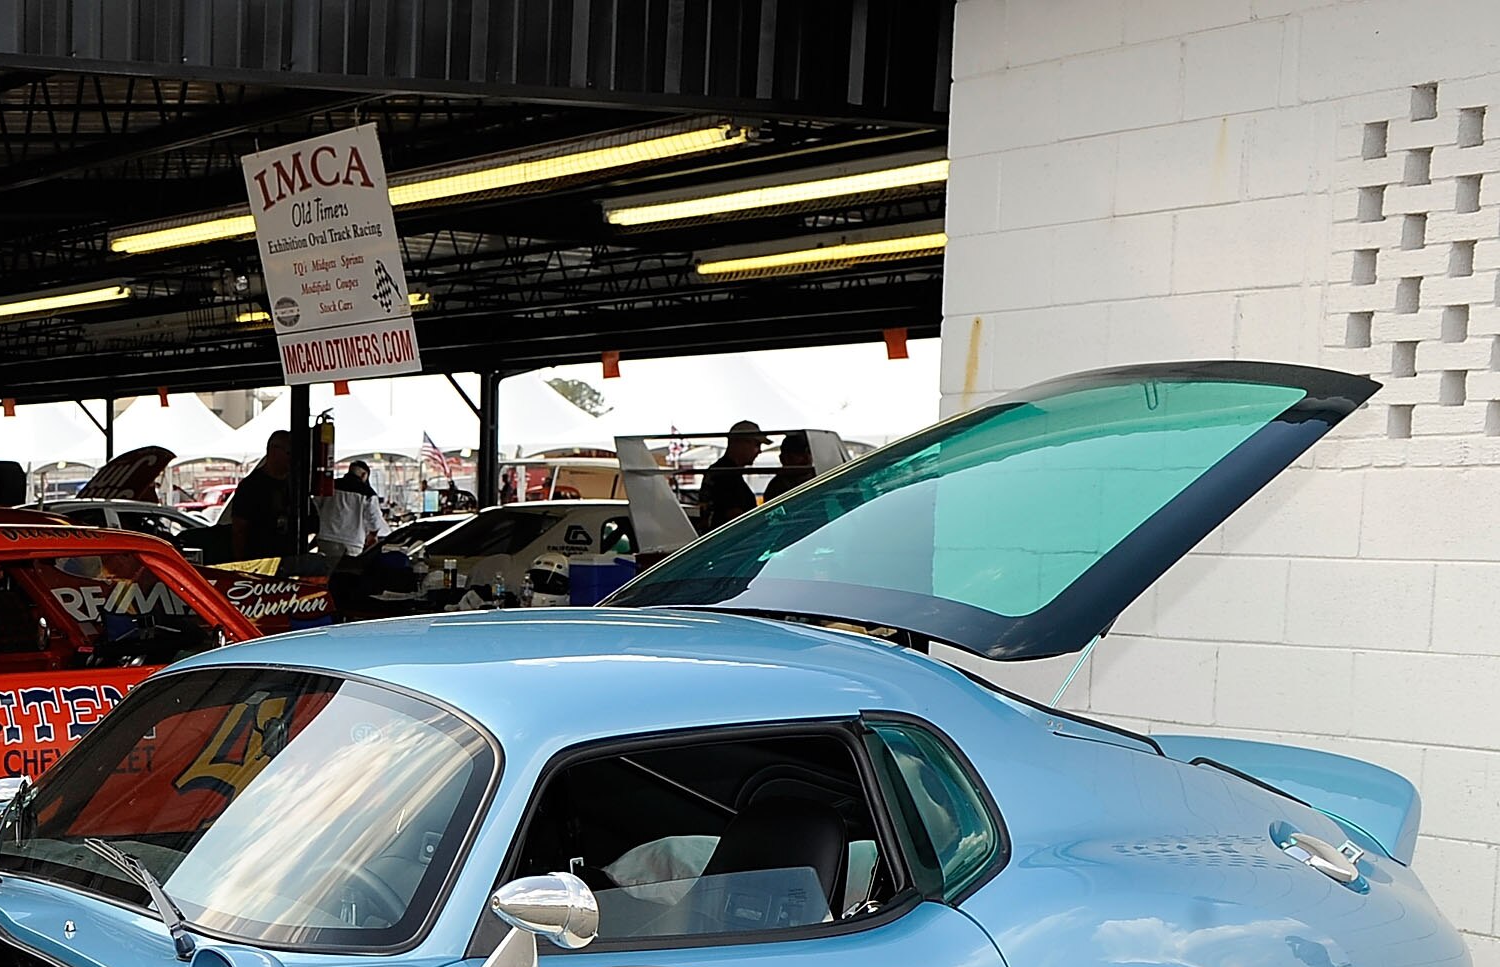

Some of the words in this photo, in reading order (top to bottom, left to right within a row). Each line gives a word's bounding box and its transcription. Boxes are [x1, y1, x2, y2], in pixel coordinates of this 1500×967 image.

[254, 146, 374, 211] IMCA
[291, 202, 312, 228] Old
[314, 197, 349, 222] Timers
[268, 236, 308, 254] Exhibition
[308, 230, 327, 246] Oval
[327, 226, 351, 243] Track
[352, 221, 382, 240] Racing
[312, 258, 337, 272] Midgets
[340, 253, 364, 268] Sprints
[335, 278, 359, 291] Coupes
[319, 301, 337, 314] Stock
[337, 299, 353, 311] Cars
[282, 329, 415, 375] IMCAOLDTIMERS.COM
